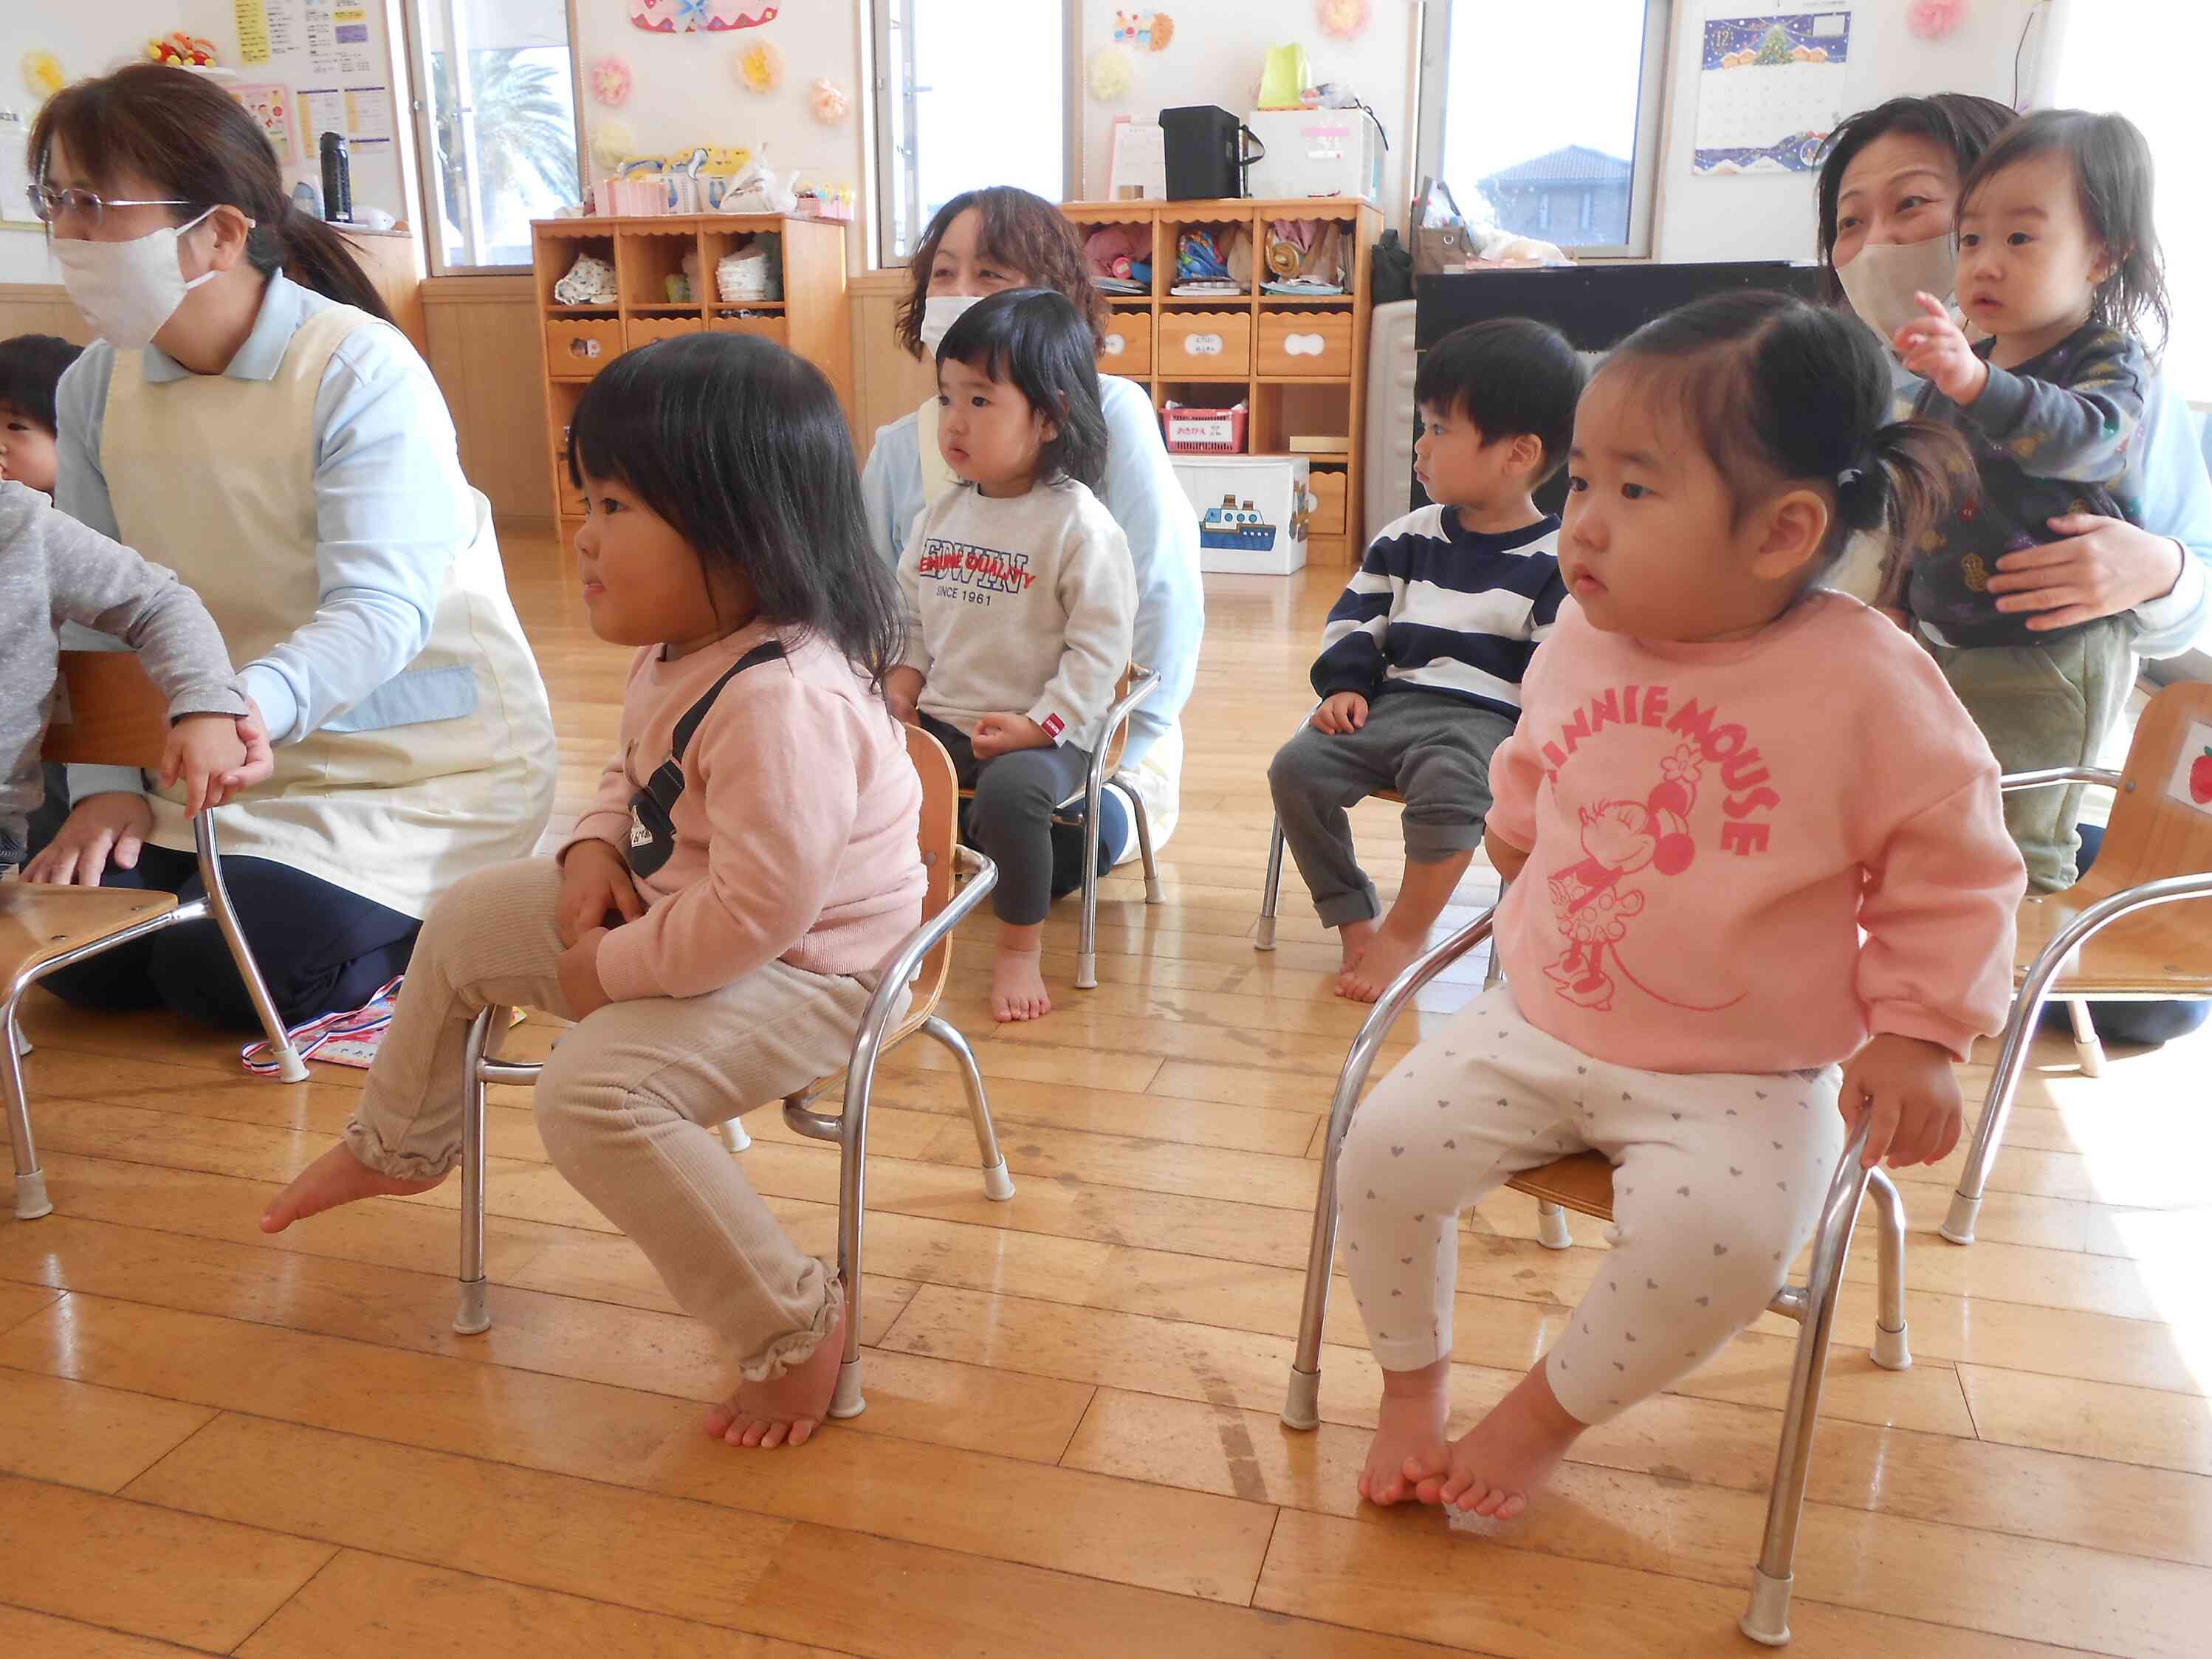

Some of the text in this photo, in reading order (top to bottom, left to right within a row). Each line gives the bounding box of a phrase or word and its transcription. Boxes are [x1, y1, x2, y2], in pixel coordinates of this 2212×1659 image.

[920, 538, 1028, 594] EDWIN
[965, 554, 1035, 589] QUALITY
[936, 585, 992, 606] SINCE 1961
[1542, 684, 1781, 857] INNIE MOUSE
